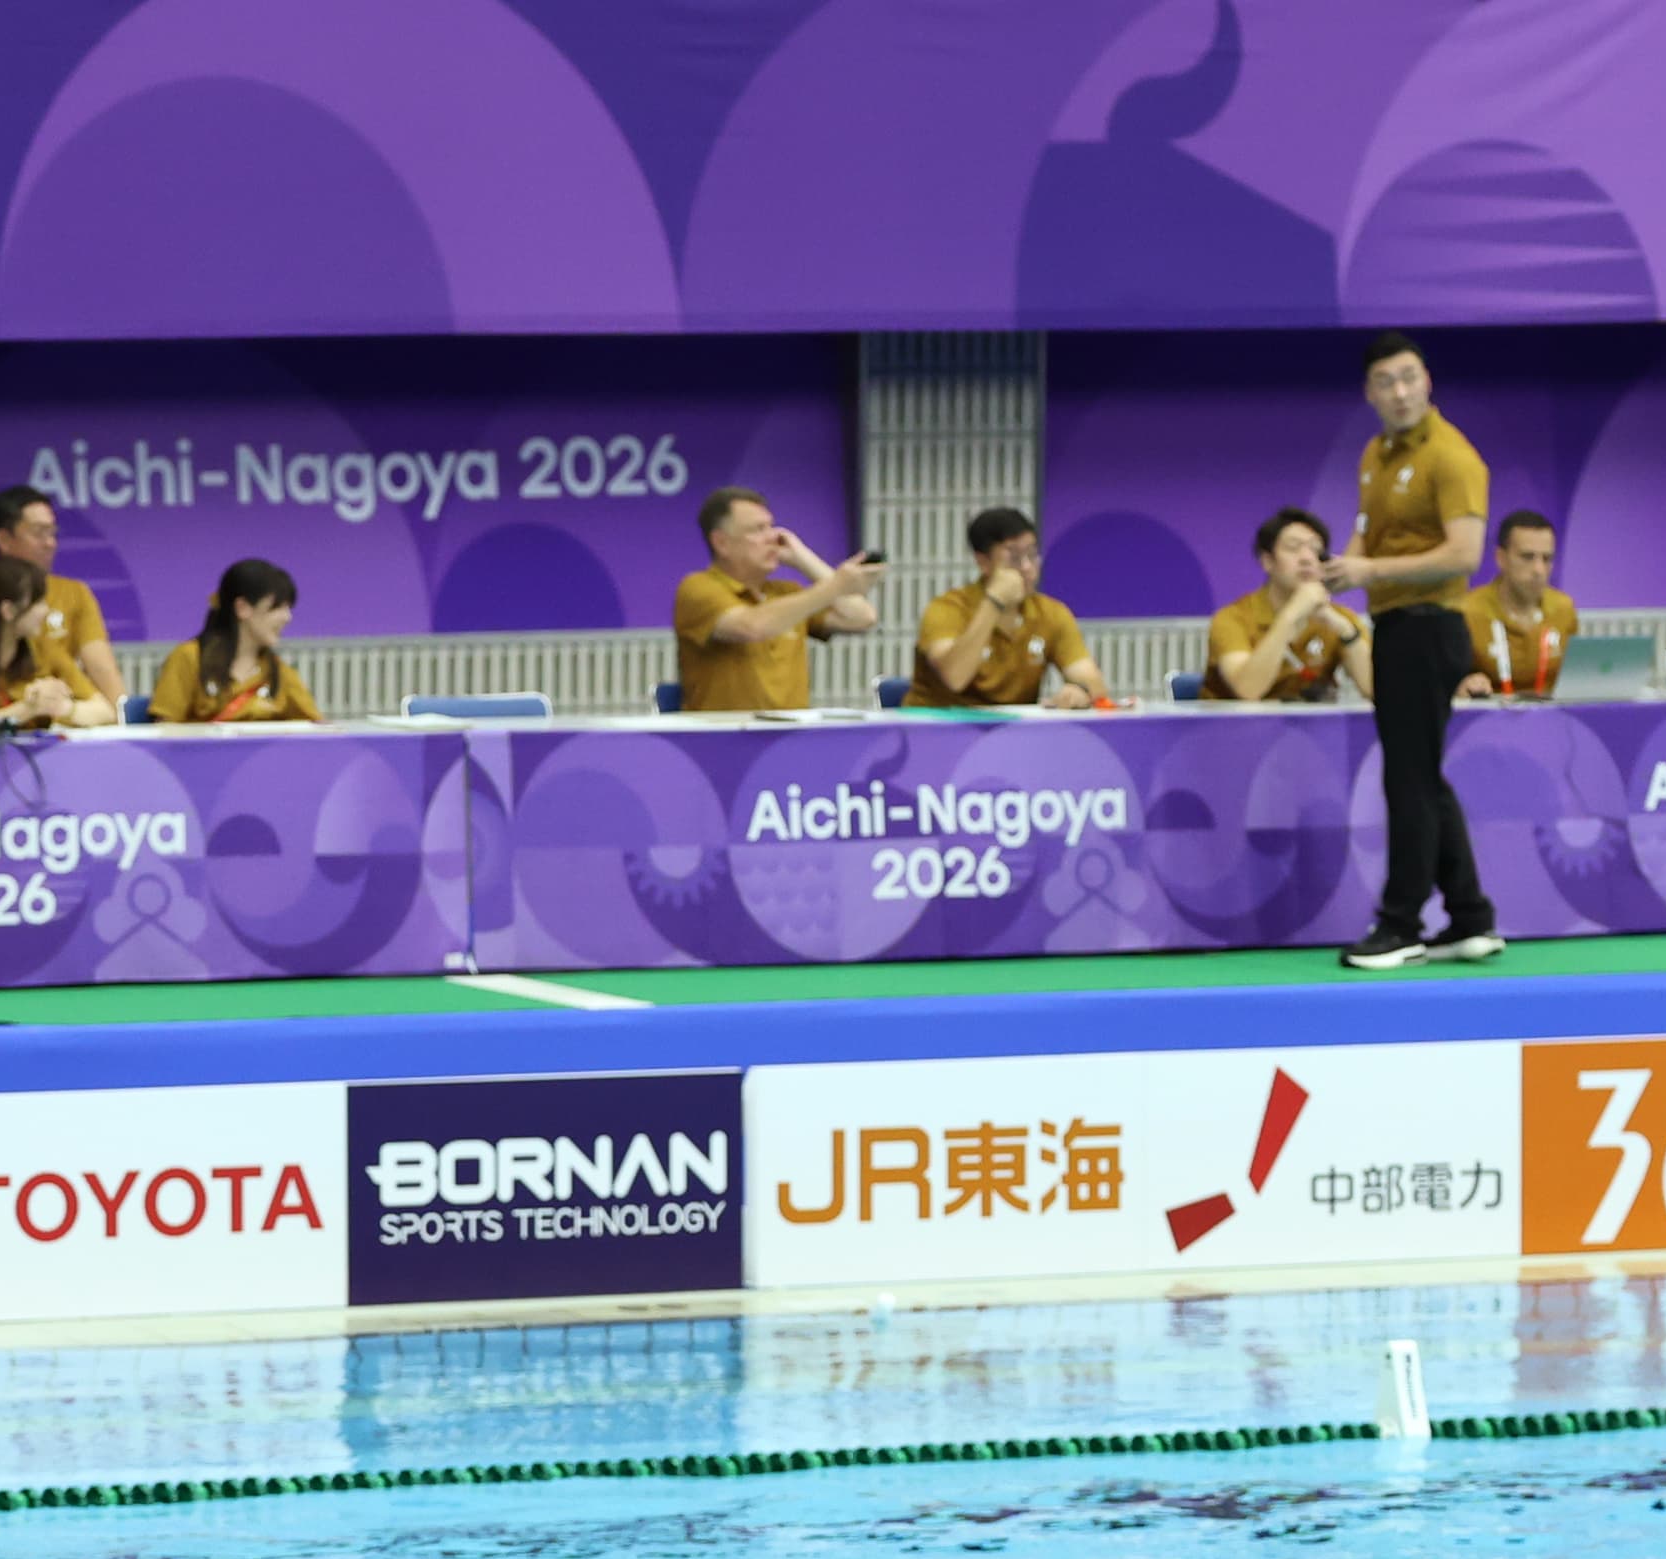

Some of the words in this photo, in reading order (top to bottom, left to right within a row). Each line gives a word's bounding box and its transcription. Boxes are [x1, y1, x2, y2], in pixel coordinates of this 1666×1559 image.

[27, 438, 500, 523] Aichi-Nagoya
[519, 434, 688, 499] 2026
[746, 779, 1128, 849] Aichi-Nagoya
[870, 845, 1013, 902] 2026
[364, 1129, 729, 1206] BORNAN
[777, 1117, 1125, 1225] JR東海
[1310, 1161, 1504, 1215] 中部電力
[379, 1208, 504, 1246] SPORTS
[517, 1200, 728, 1241] TECHNOLOGY
